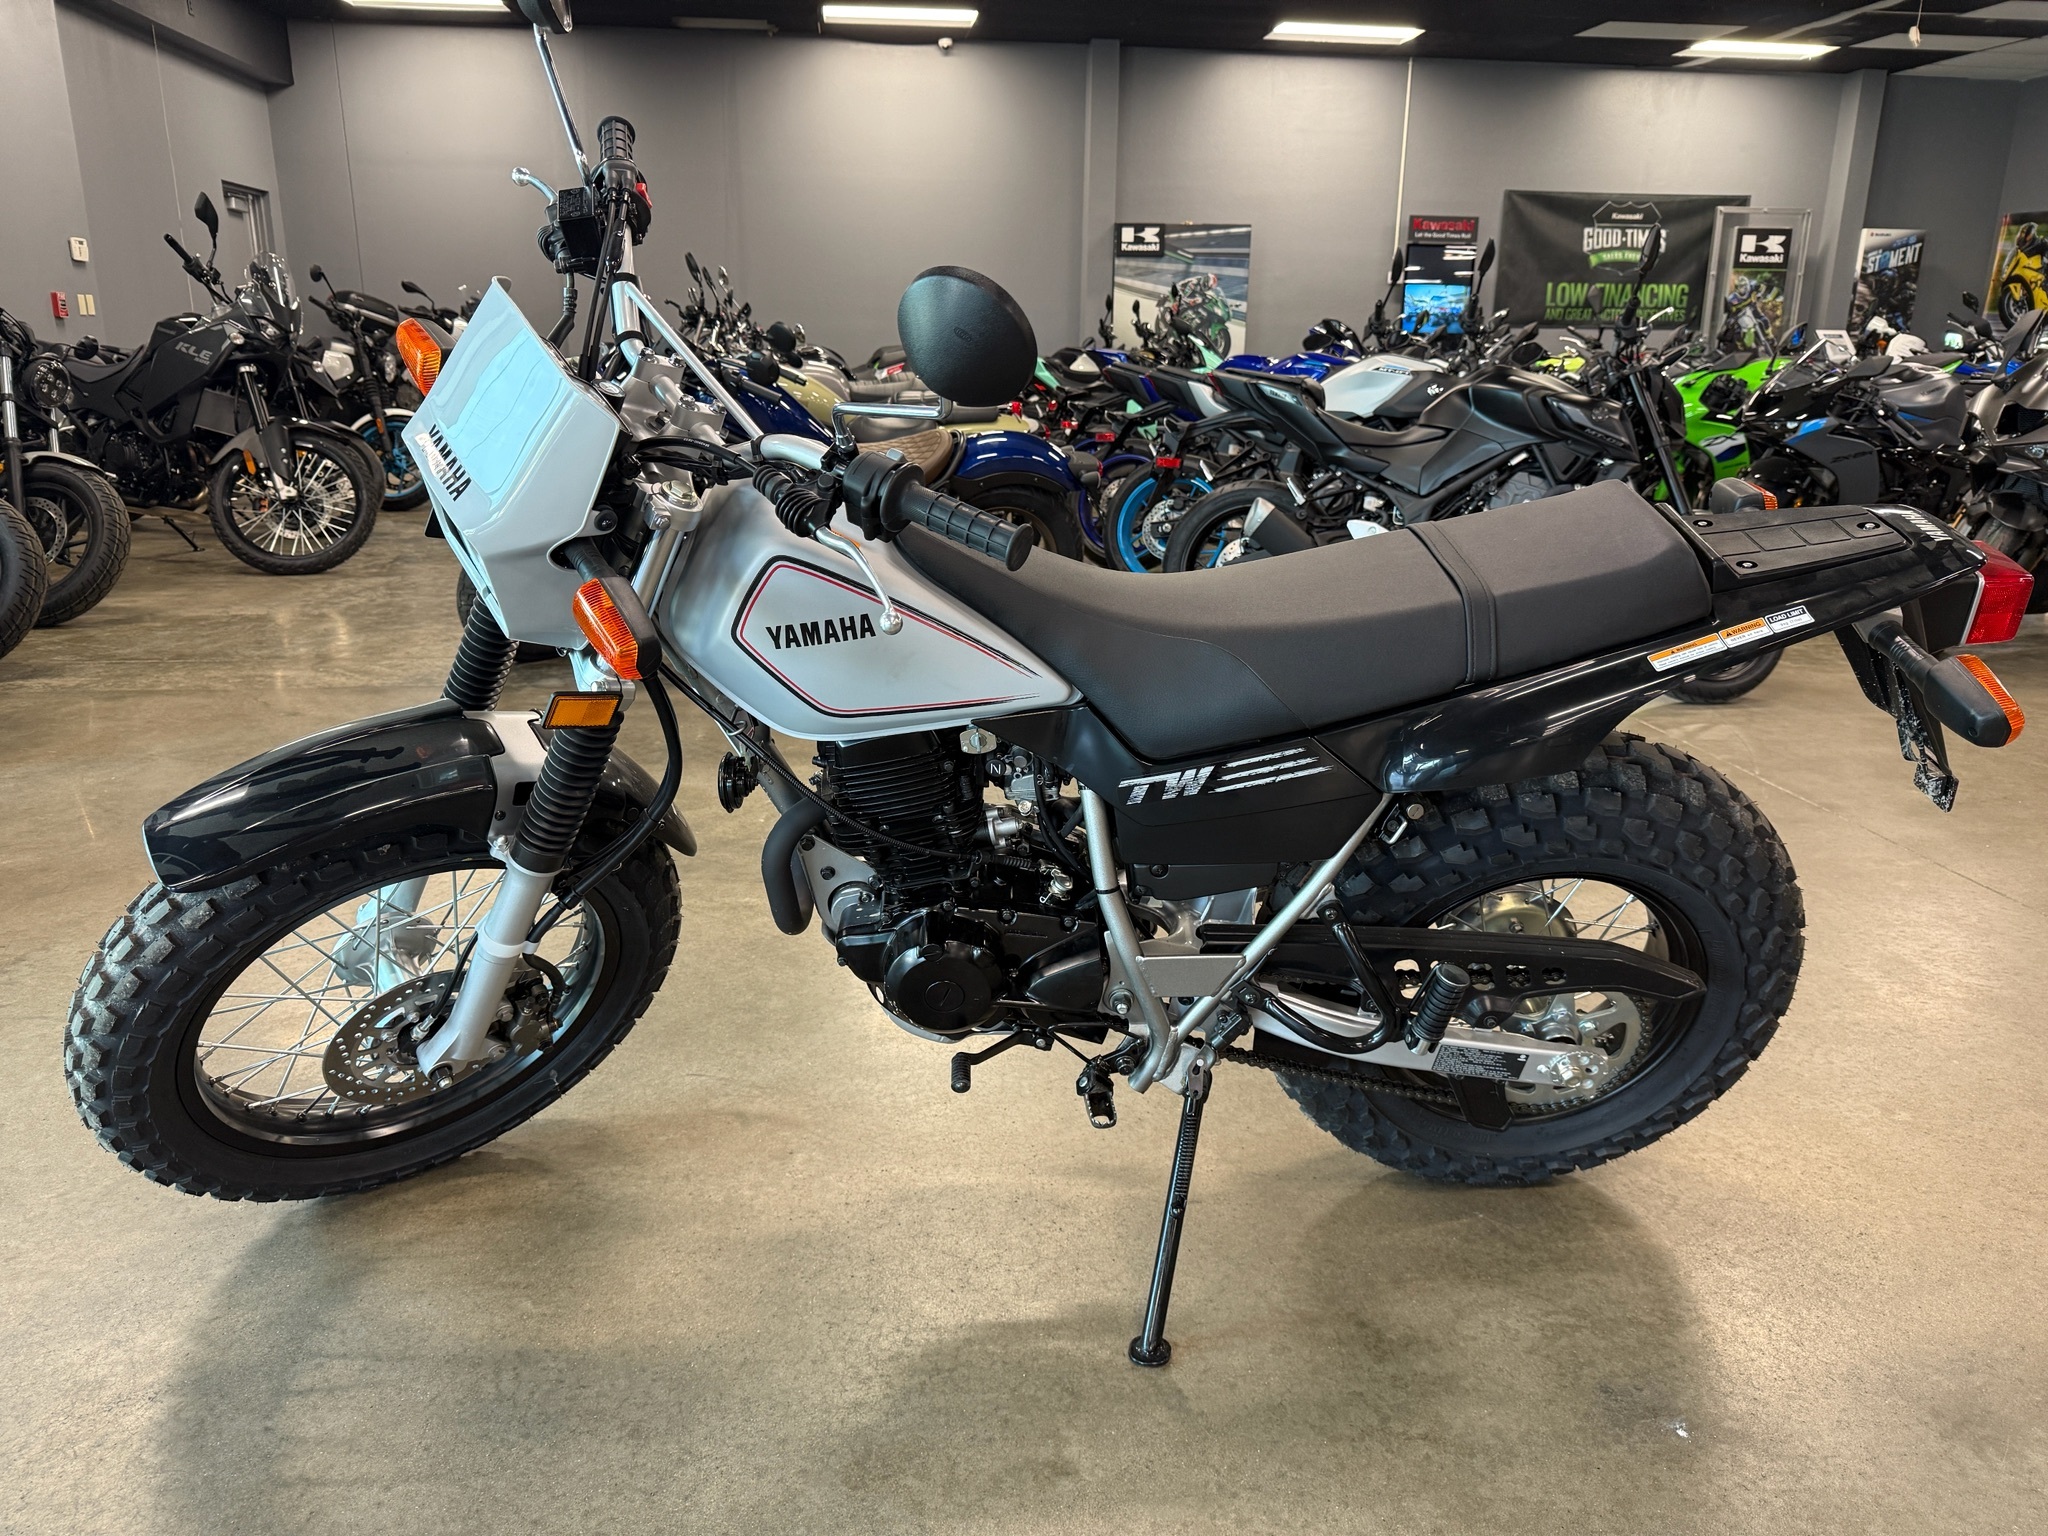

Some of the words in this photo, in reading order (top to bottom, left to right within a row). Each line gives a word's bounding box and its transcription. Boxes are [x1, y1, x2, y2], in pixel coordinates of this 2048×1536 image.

[1413, 218, 1475, 231] Kawasaki
[1121, 243, 1160, 252] Kawasaki
[1739, 253, 1784, 264] Kawasaki
[1545, 282, 1589, 307] LOW
[1545, 307, 1564, 321] AND
[175, 341, 213, 360] KLE
[1769, 613, 1787, 623] LOAD
[1787, 608, 1804, 618] LIMIT
[765, 613, 877, 650] YAMAHA
[1732, 621, 1762, 635] WARNING
[1118, 765, 1215, 805] TW
